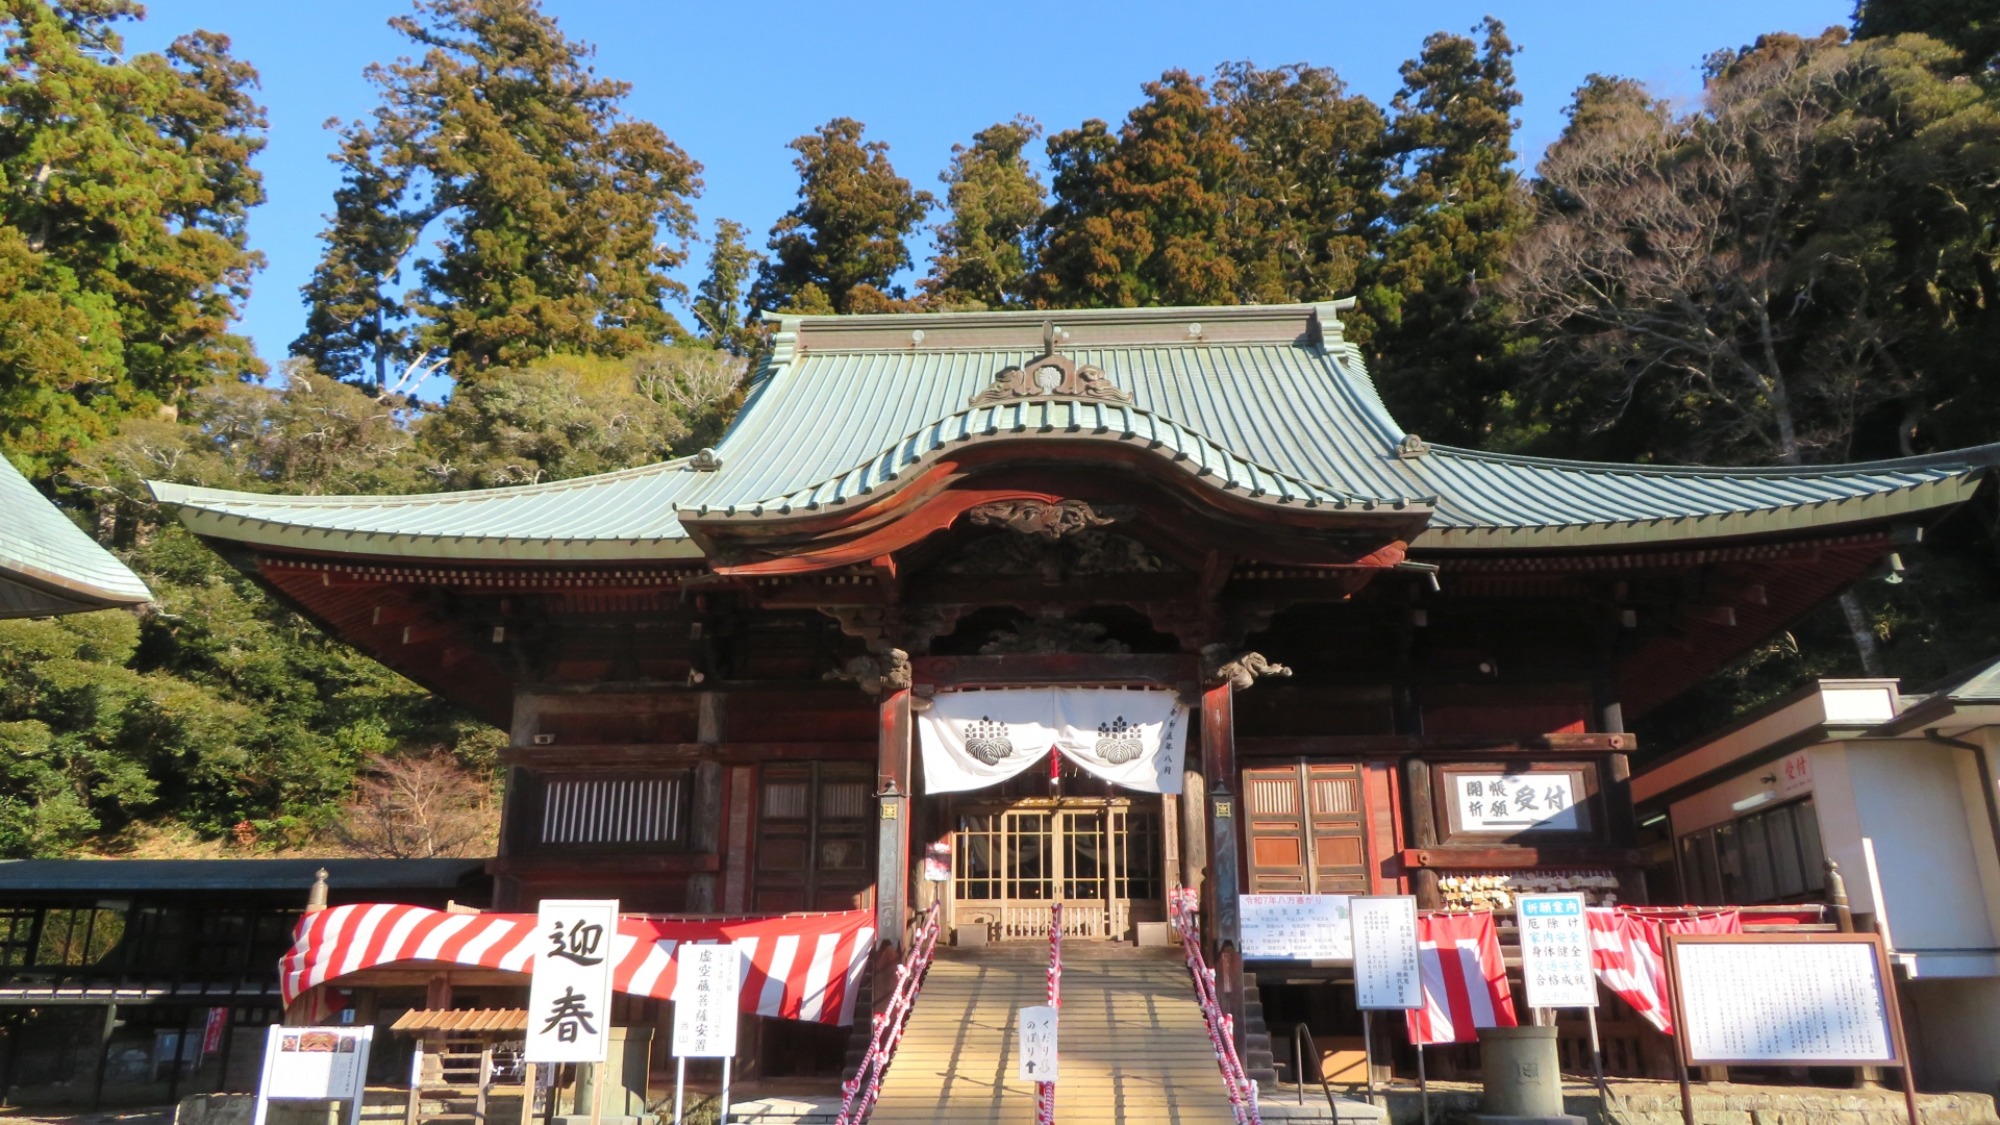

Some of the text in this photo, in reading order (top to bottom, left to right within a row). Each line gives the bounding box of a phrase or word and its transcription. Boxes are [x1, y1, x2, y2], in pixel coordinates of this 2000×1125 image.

[1164, 708, 1177, 775] 令和五年八月
[1785, 755, 1806, 780] 受付
[1467, 780, 1508, 797] 開帳
[1514, 784, 1566, 812] 受付
[1469, 800, 1509, 817] 祈願
[1245, 896, 1322, 905] 令和7年八方塞がり
[1527, 901, 1577, 913] 祈願案内
[1528, 918, 1579, 929] 厄除け
[1529, 931, 1580, 943] 家内安全
[1532, 945, 1582, 958] 身体健全
[1534, 959, 1583, 972] 交通安全
[539, 918, 605, 1044] 迎春
[1536, 974, 1587, 986] 合格成就
[695, 949, 713, 1053] 虚空蔵菩薩安置
[1026, 1021, 1037, 1058] のぼり
[1042, 1020, 1050, 1057] くだり
